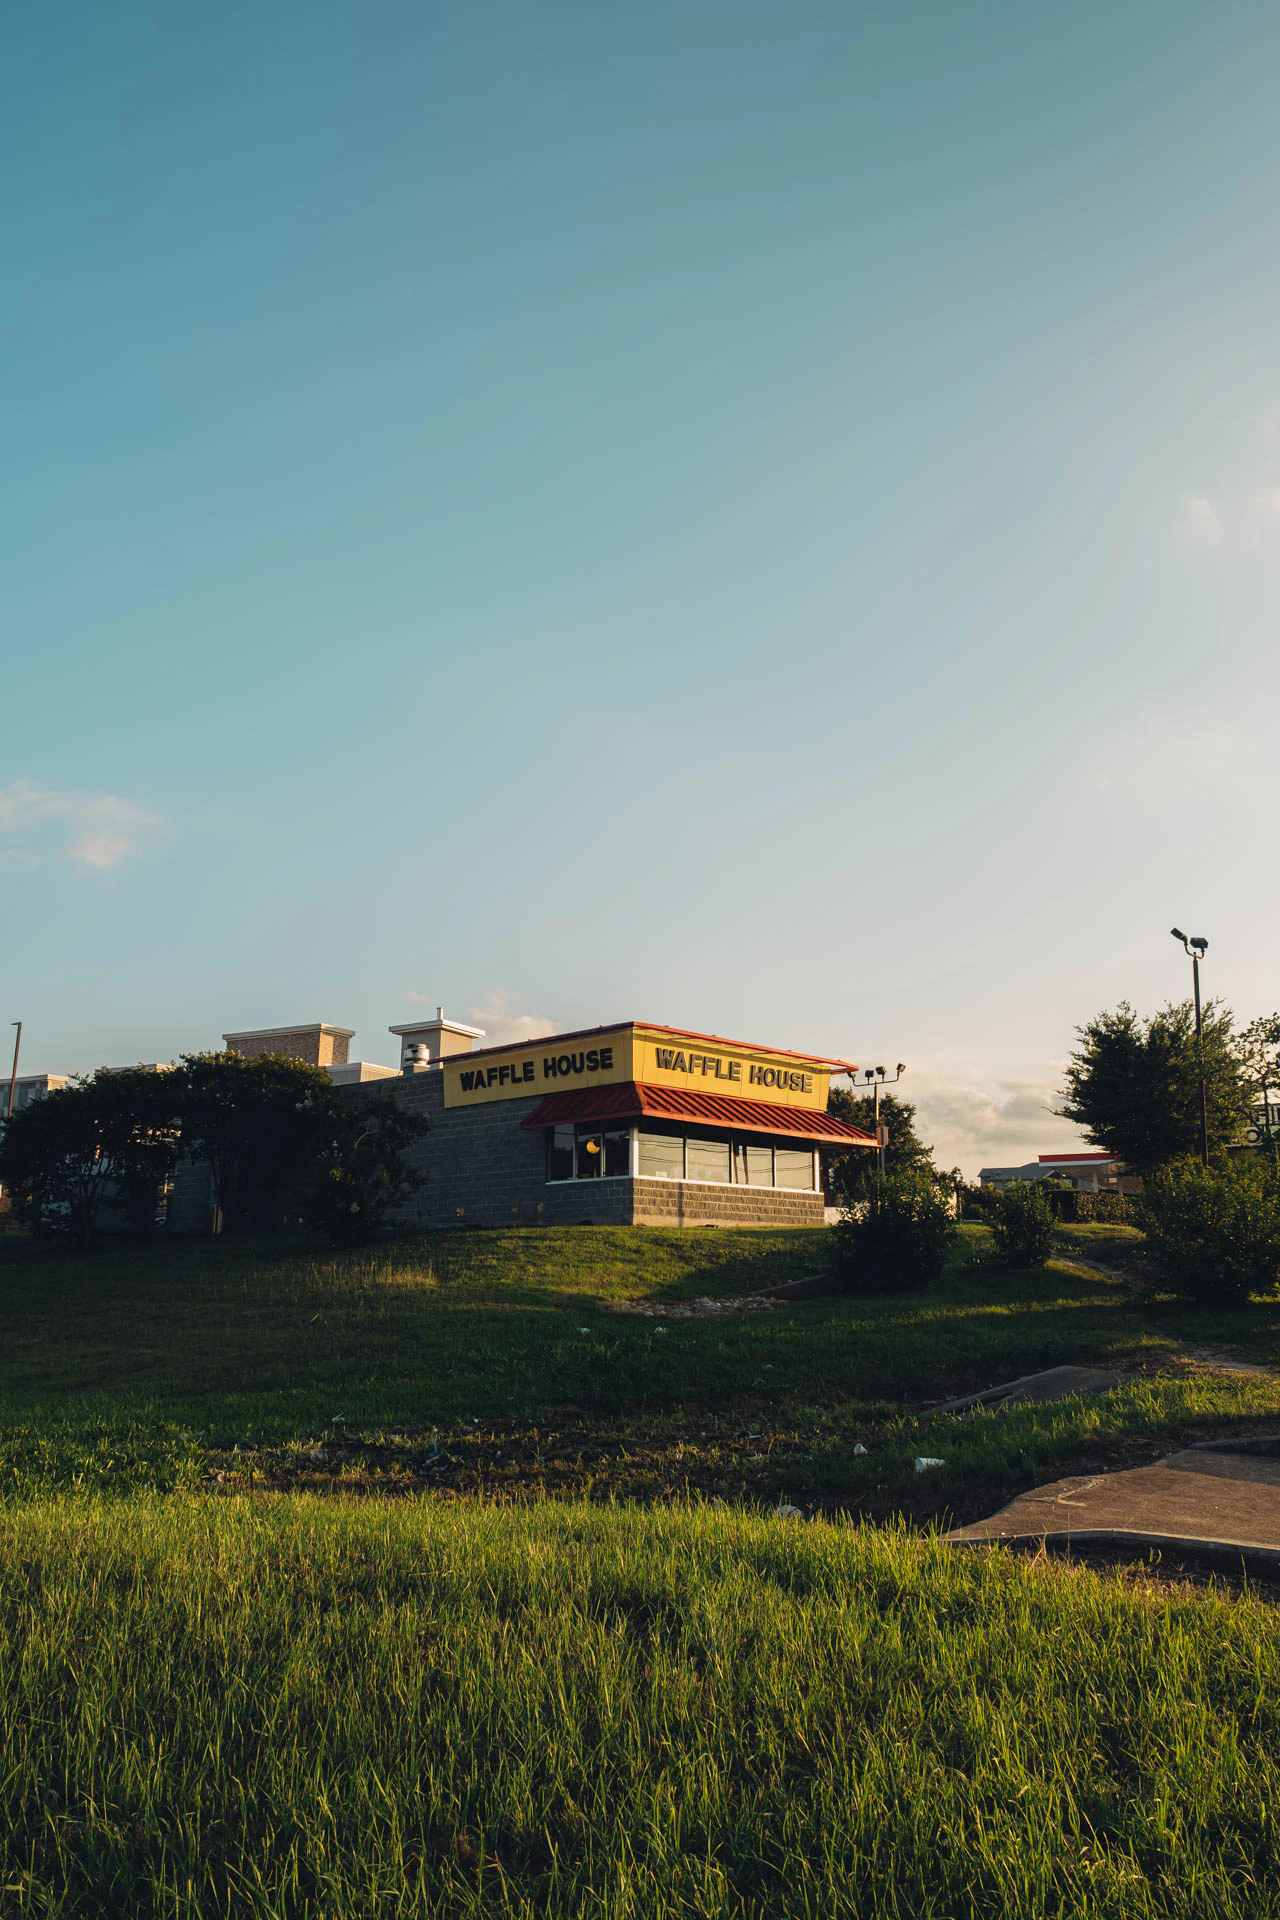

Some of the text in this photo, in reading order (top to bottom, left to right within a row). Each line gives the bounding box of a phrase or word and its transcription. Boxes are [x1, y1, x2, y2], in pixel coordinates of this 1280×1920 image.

[460, 1047, 613, 1091] WAFFLE HOUSE
[656, 1047, 812, 1093] WAFFLE HOUSE
